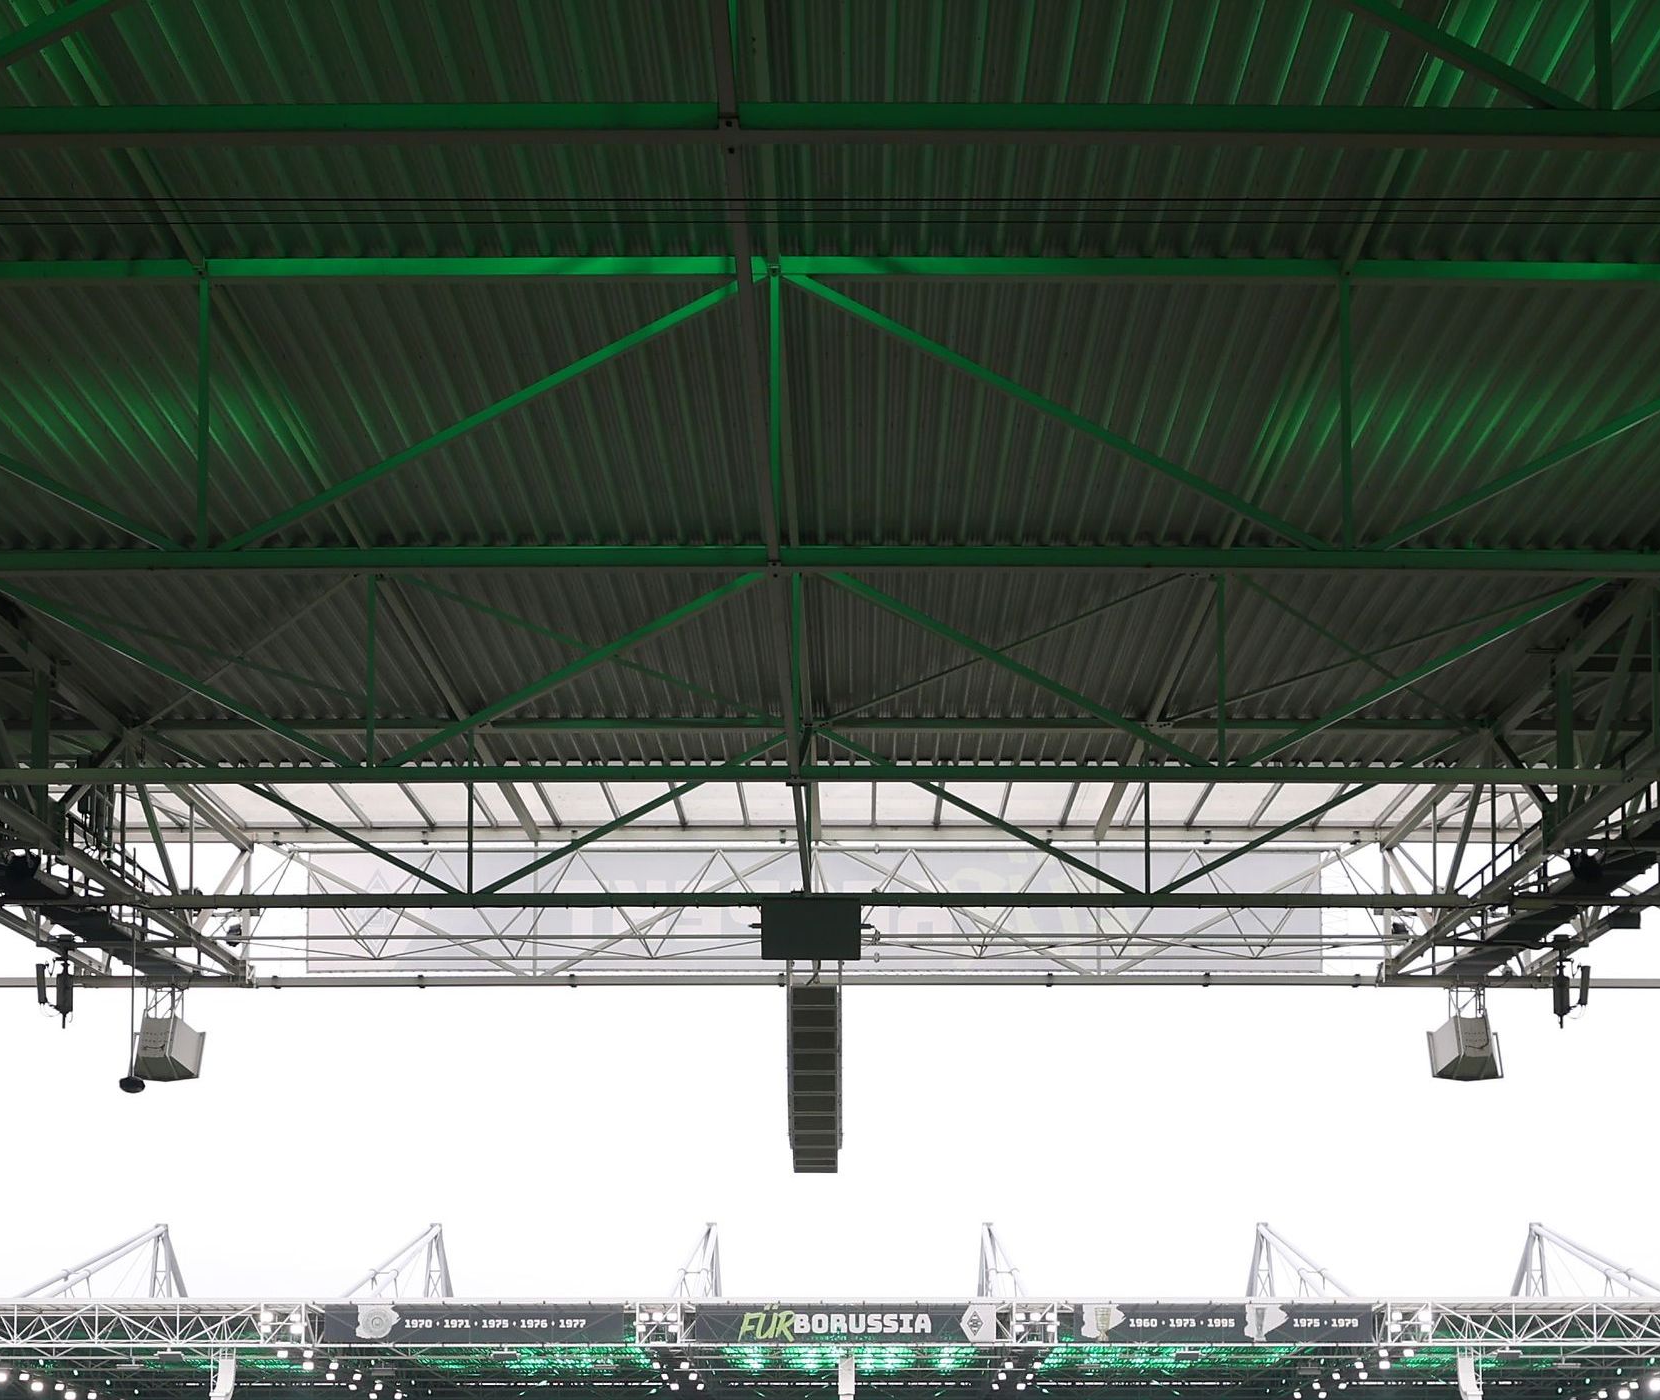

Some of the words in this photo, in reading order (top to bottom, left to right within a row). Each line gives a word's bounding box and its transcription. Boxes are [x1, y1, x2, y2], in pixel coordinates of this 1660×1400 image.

[404, 1318, 433, 1329] 1970
[444, 1318, 471, 1329] 1971
[481, 1318, 509, 1329] 1975
[520, 1318, 548, 1329] 1976
[558, 1318, 586, 1329] 1977
[1129, 1317, 1157, 1329] 1960
[1168, 1317, 1197, 1329] 1973
[1207, 1317, 1236, 1329] 1995
[1293, 1317, 1321, 1329] 1975
[1331, 1317, 1359, 1329] 1979
